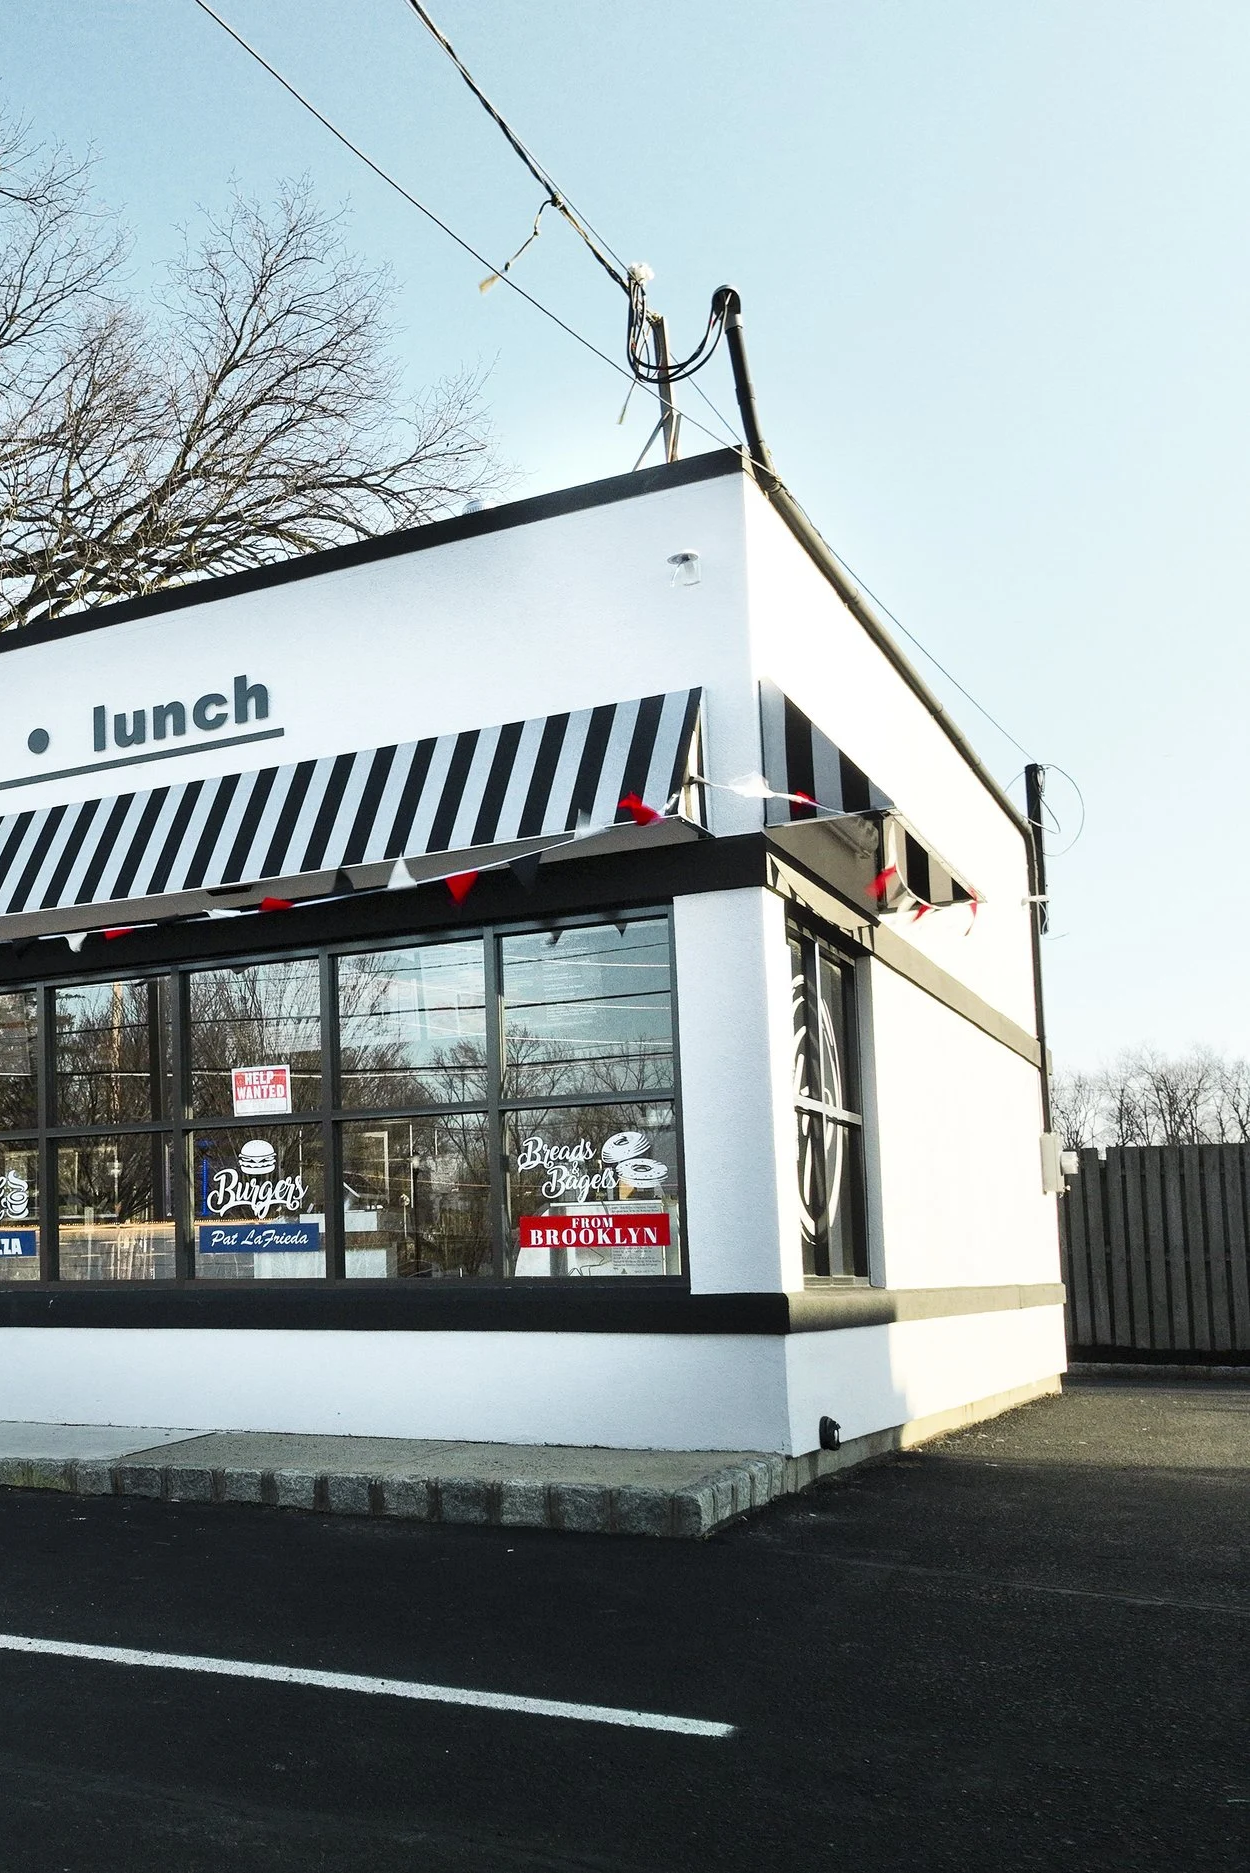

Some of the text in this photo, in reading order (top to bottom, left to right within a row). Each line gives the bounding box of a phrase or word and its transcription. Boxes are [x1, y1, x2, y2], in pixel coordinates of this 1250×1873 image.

[93, 674, 270, 752] lunch
[244, 1071, 274, 1085] HELP
[237, 1084, 285, 1099] WANTED
[517, 1136, 597, 1173] Breads
[571, 1160, 580, 1176] &
[207, 1168, 309, 1219] Burgers
[542, 1165, 620, 1203] Bagels
[571, 1217, 614, 1229] FROM
[211, 1229, 309, 1248] Pat LaFrieda
[530, 1227, 658, 1246] BROOKLYN
